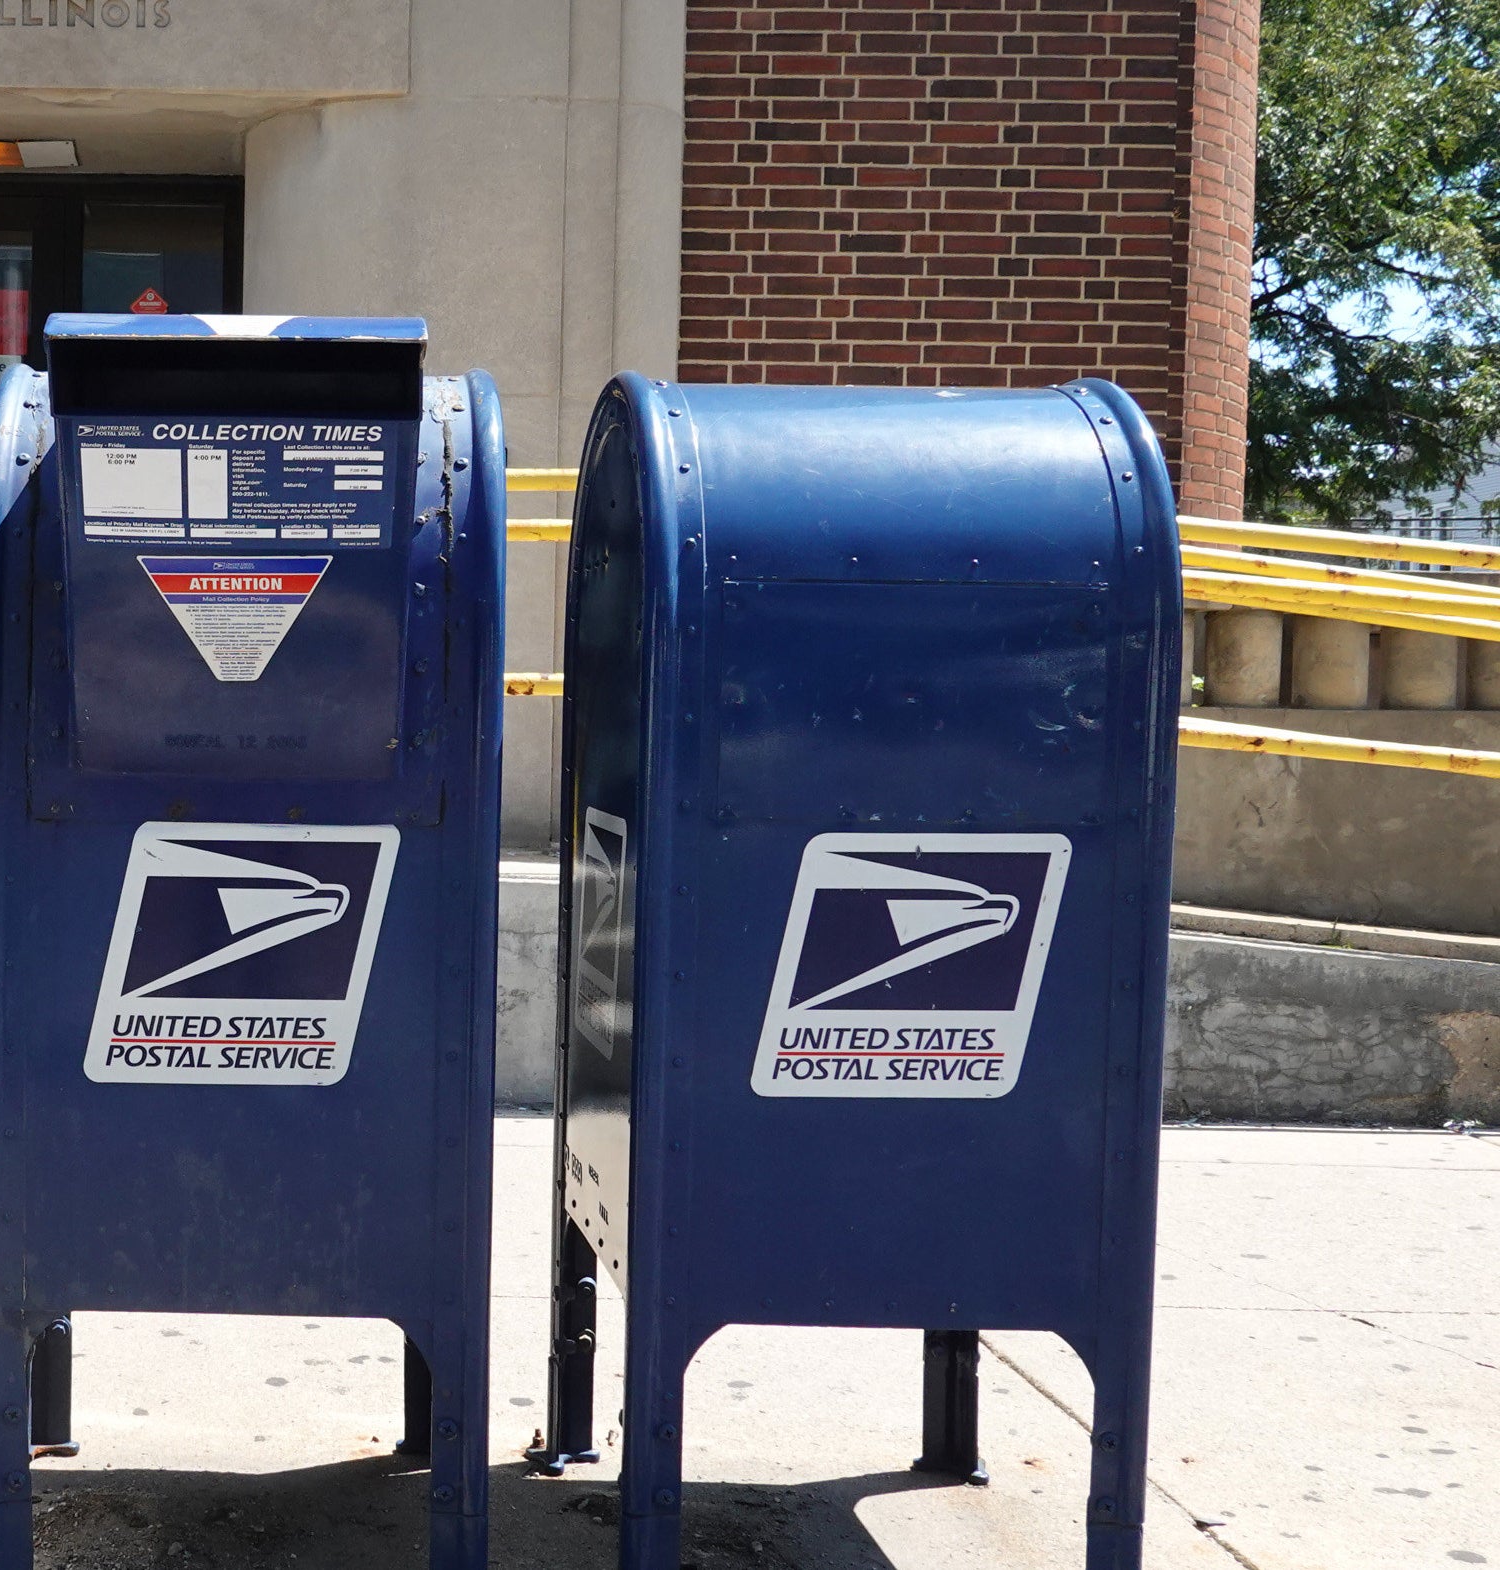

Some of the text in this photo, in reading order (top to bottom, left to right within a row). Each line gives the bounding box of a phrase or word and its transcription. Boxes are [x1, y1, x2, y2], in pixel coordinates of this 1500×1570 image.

[152, 424, 383, 442] COLLECTION TIMES
[189, 577, 283, 590] ATTENTION
[113, 1015, 327, 1039] UNITED STATES
[779, 1027, 995, 1050] UNITED STATES
[106, 1045, 335, 1070] POSTAL SERVICE
[772, 1058, 1003, 1082] POSTAL SERVICE
